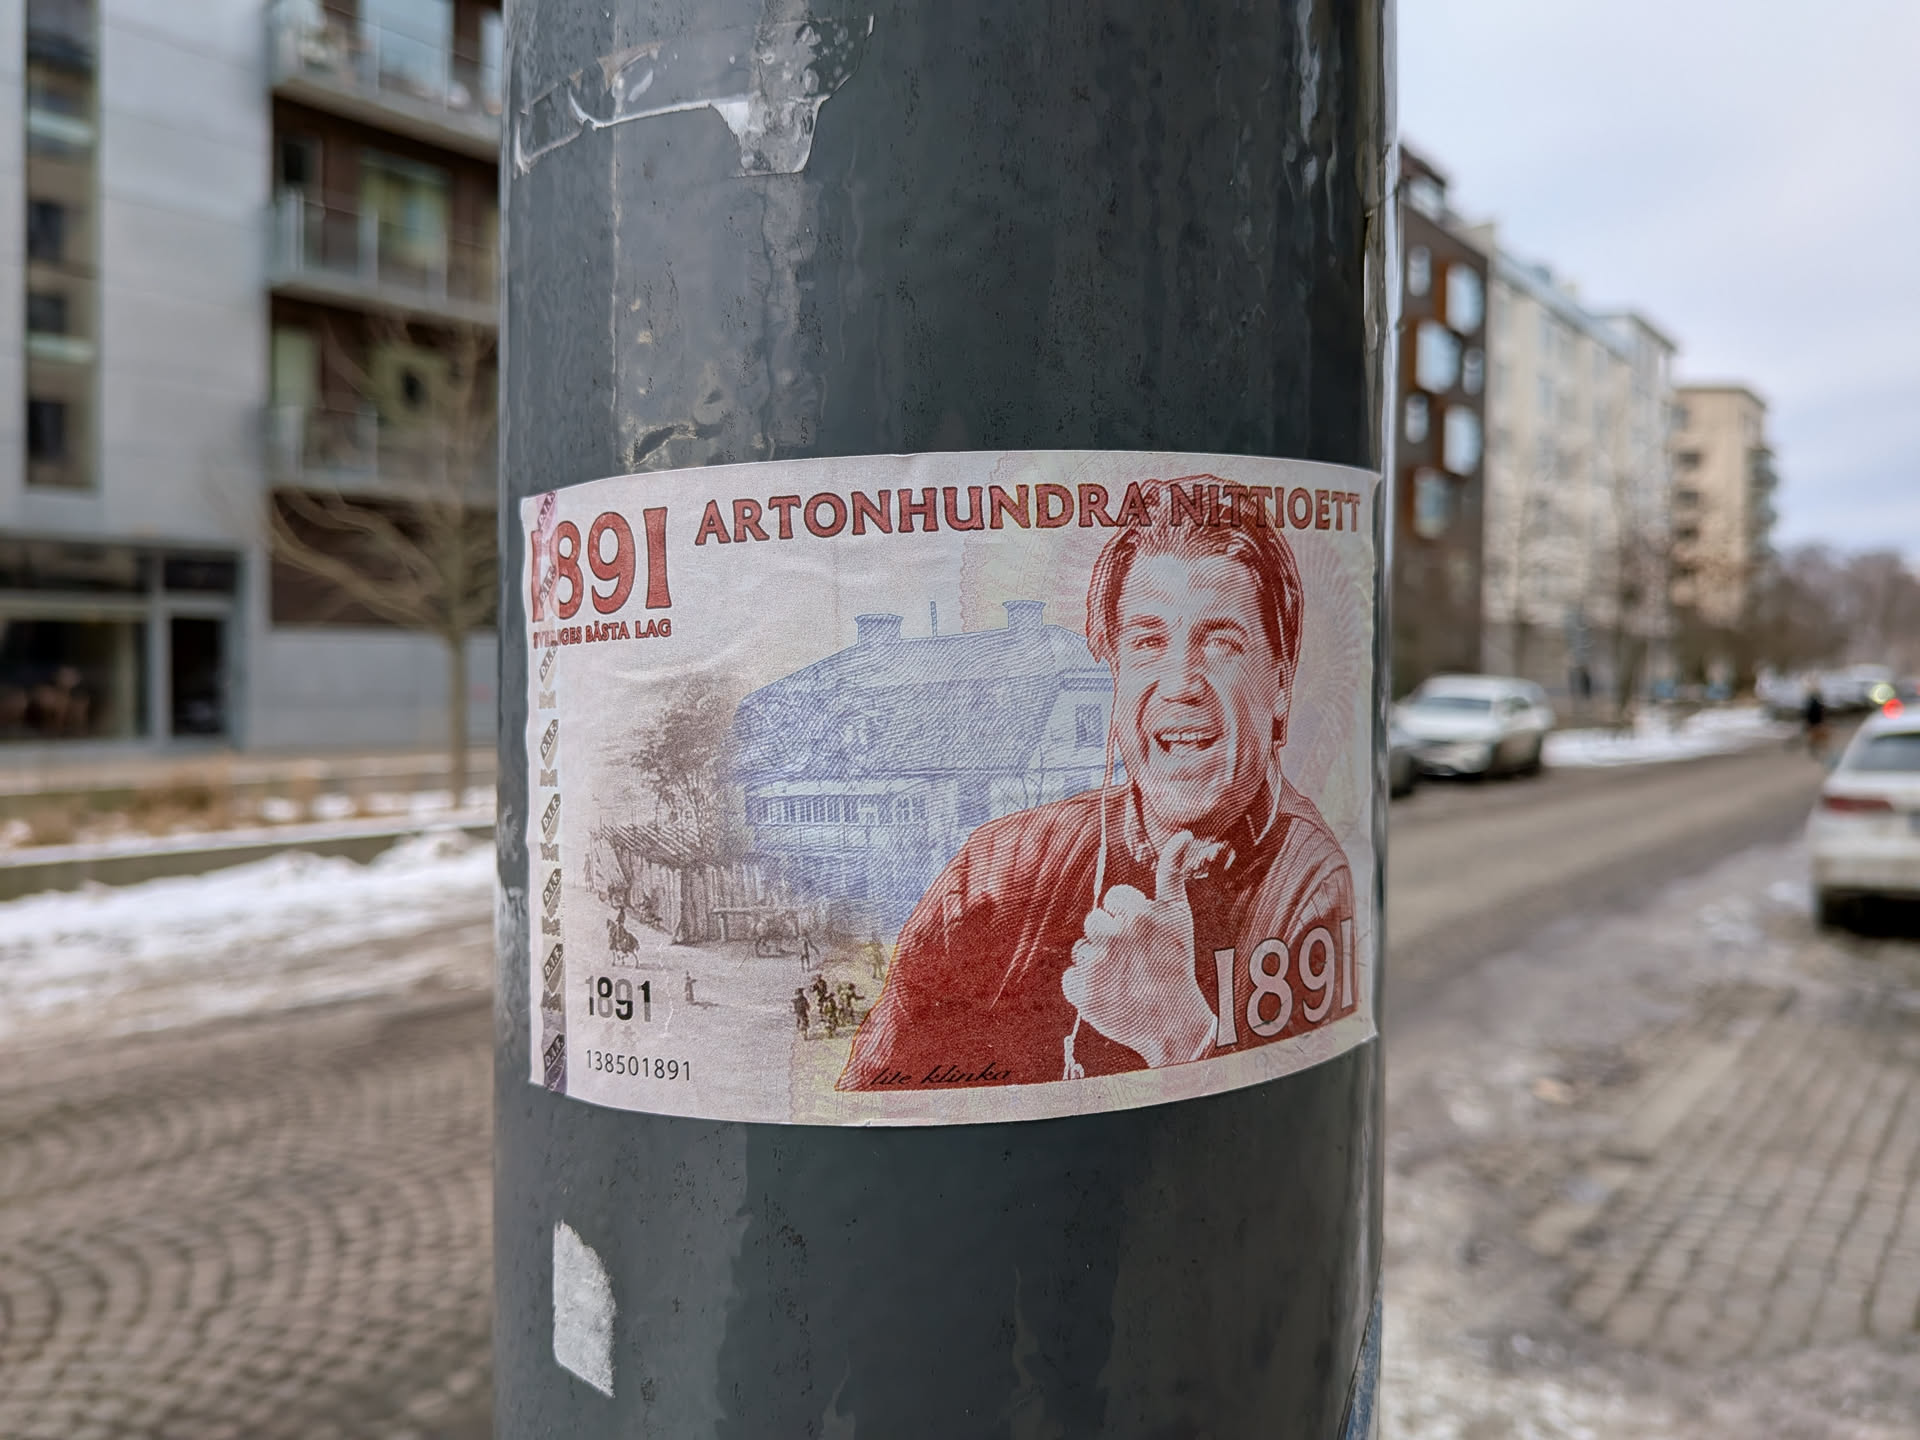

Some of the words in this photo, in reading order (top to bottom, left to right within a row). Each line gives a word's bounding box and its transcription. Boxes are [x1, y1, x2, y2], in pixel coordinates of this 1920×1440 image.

[695, 481, 1153, 546] ARTONHUNDRA
[1170, 484, 1361, 532] NITTIOETT
[531, 506, 673, 623] 1891
[586, 620, 630, 643] BÄSTA
[635, 618, 672, 639] LAG
[585, 976, 652, 1022] 1891
[1214, 917, 1353, 1048] 1891
[586, 1049, 691, 1081] 138501891
